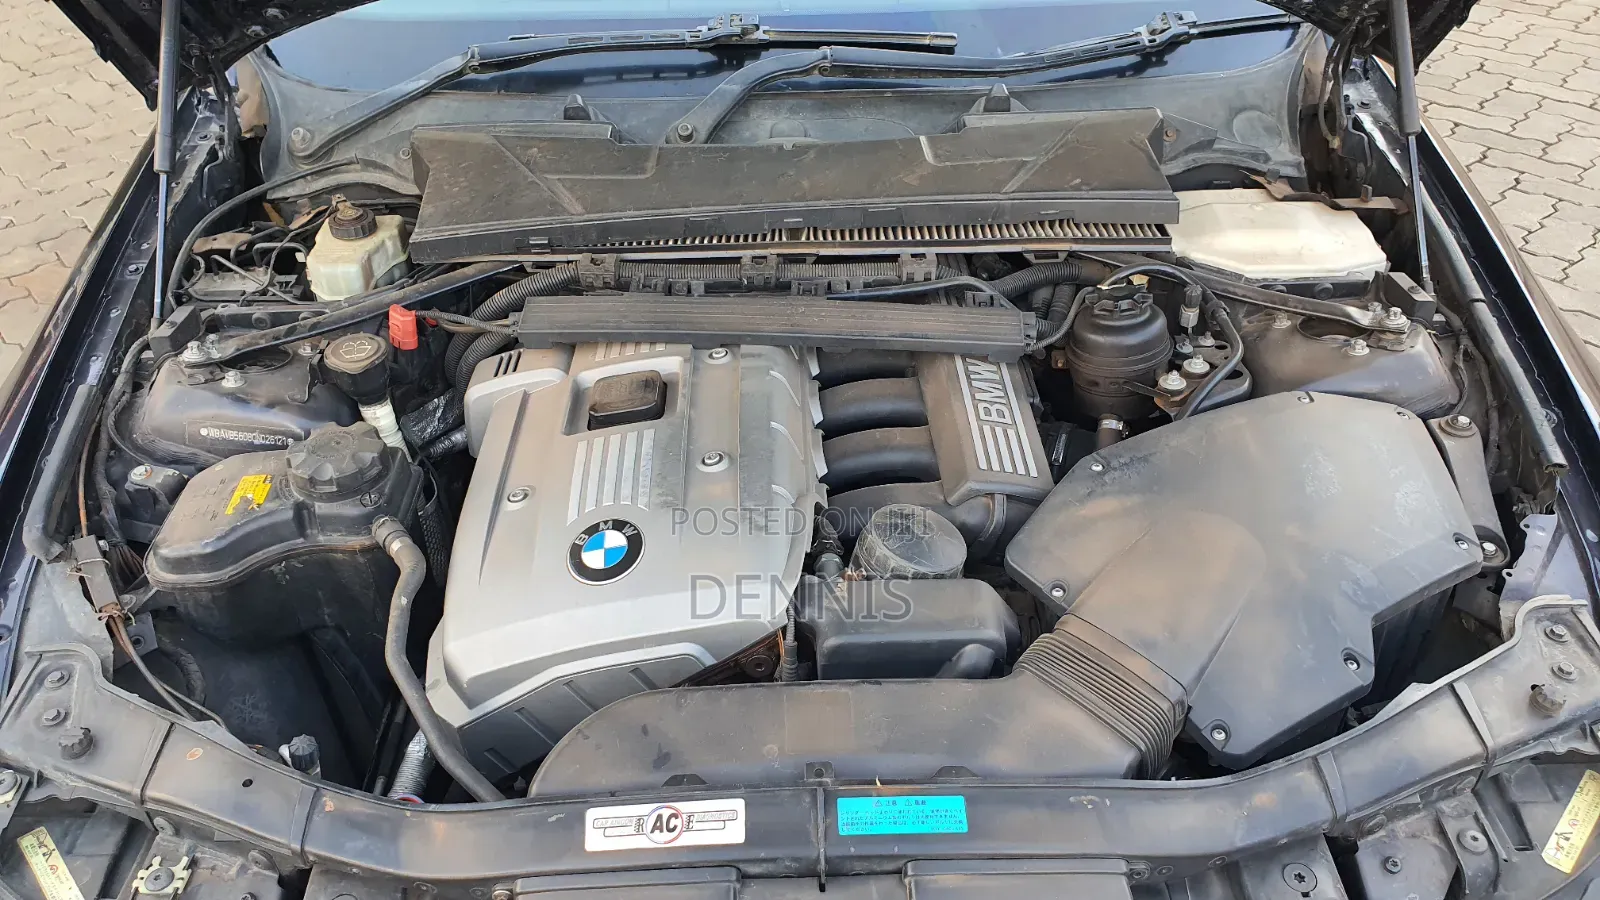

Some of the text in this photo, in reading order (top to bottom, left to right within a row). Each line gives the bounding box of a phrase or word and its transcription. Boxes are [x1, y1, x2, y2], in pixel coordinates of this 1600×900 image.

[966, 357, 1012, 425] BMW
[574, 520, 638, 545] BMW
[650, 812, 679, 834] AC
